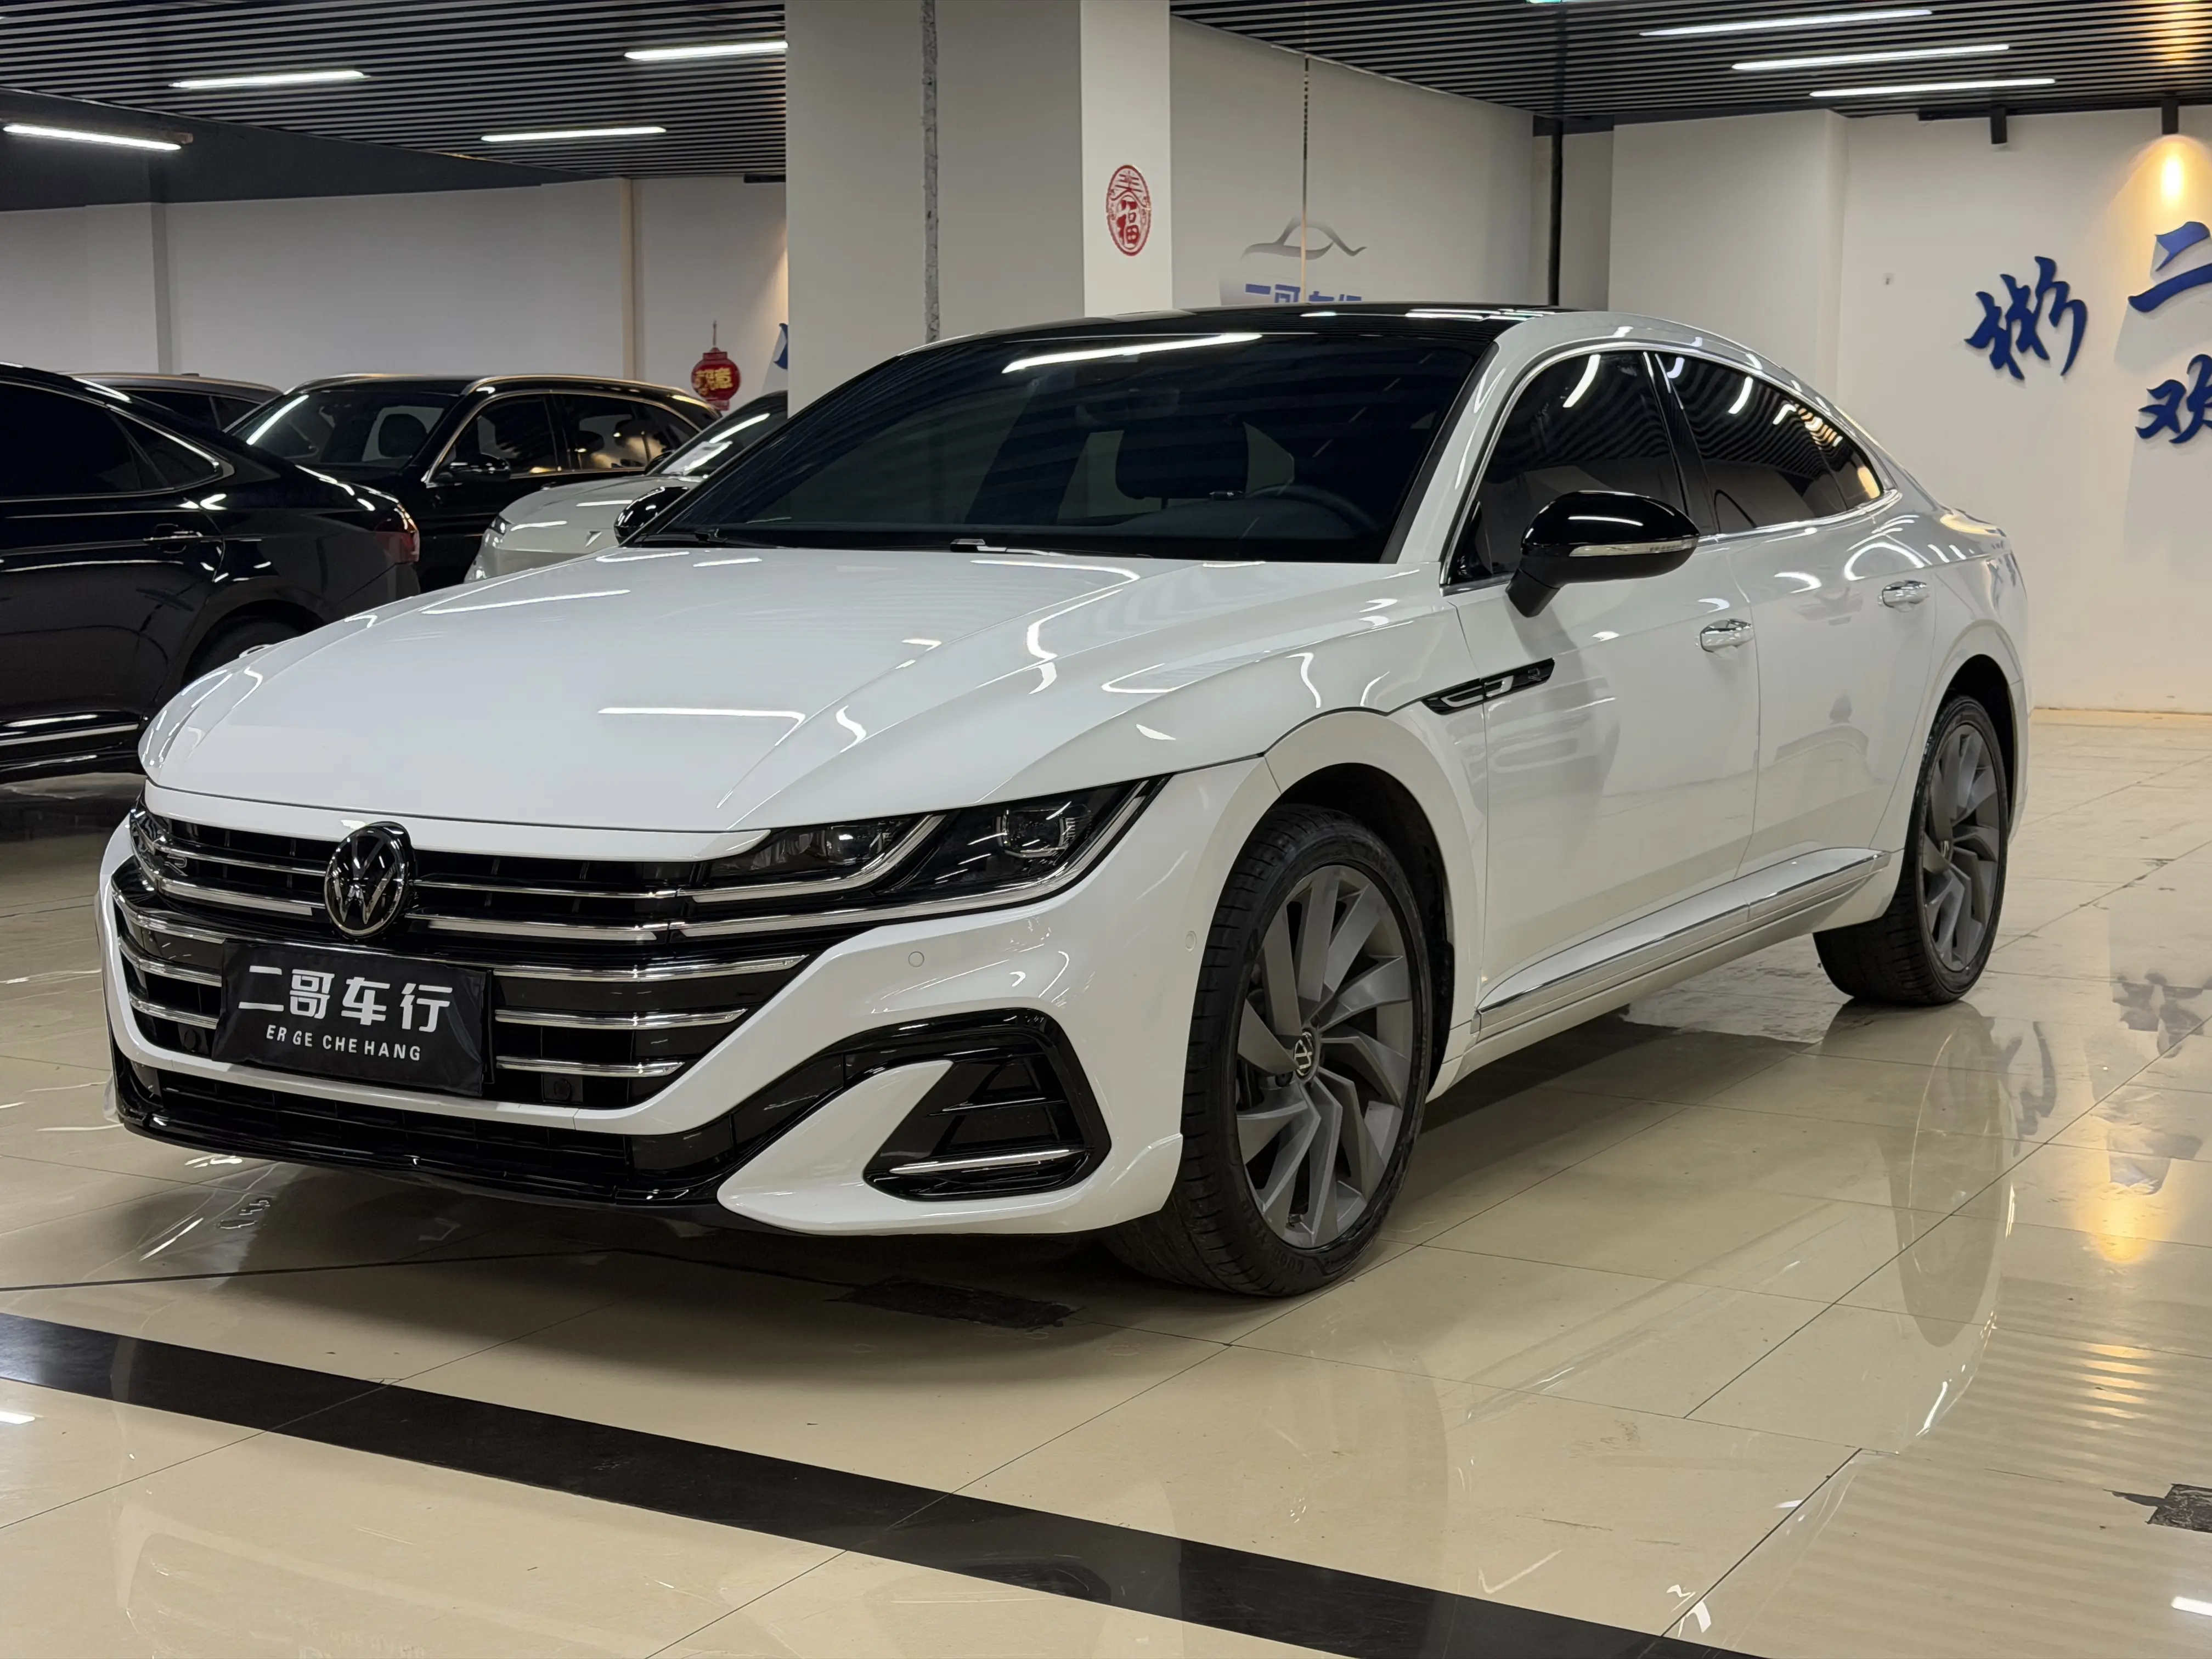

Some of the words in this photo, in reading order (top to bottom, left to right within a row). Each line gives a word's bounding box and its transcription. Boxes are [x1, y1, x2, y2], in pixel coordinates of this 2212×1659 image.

[238, 965, 454, 1033] 二哥车行
[267, 1025, 286, 1041] ER
[293, 1031, 312, 1046] GE
[323, 1035, 357, 1052] CHE
[365, 1041, 420, 1060] HANG
